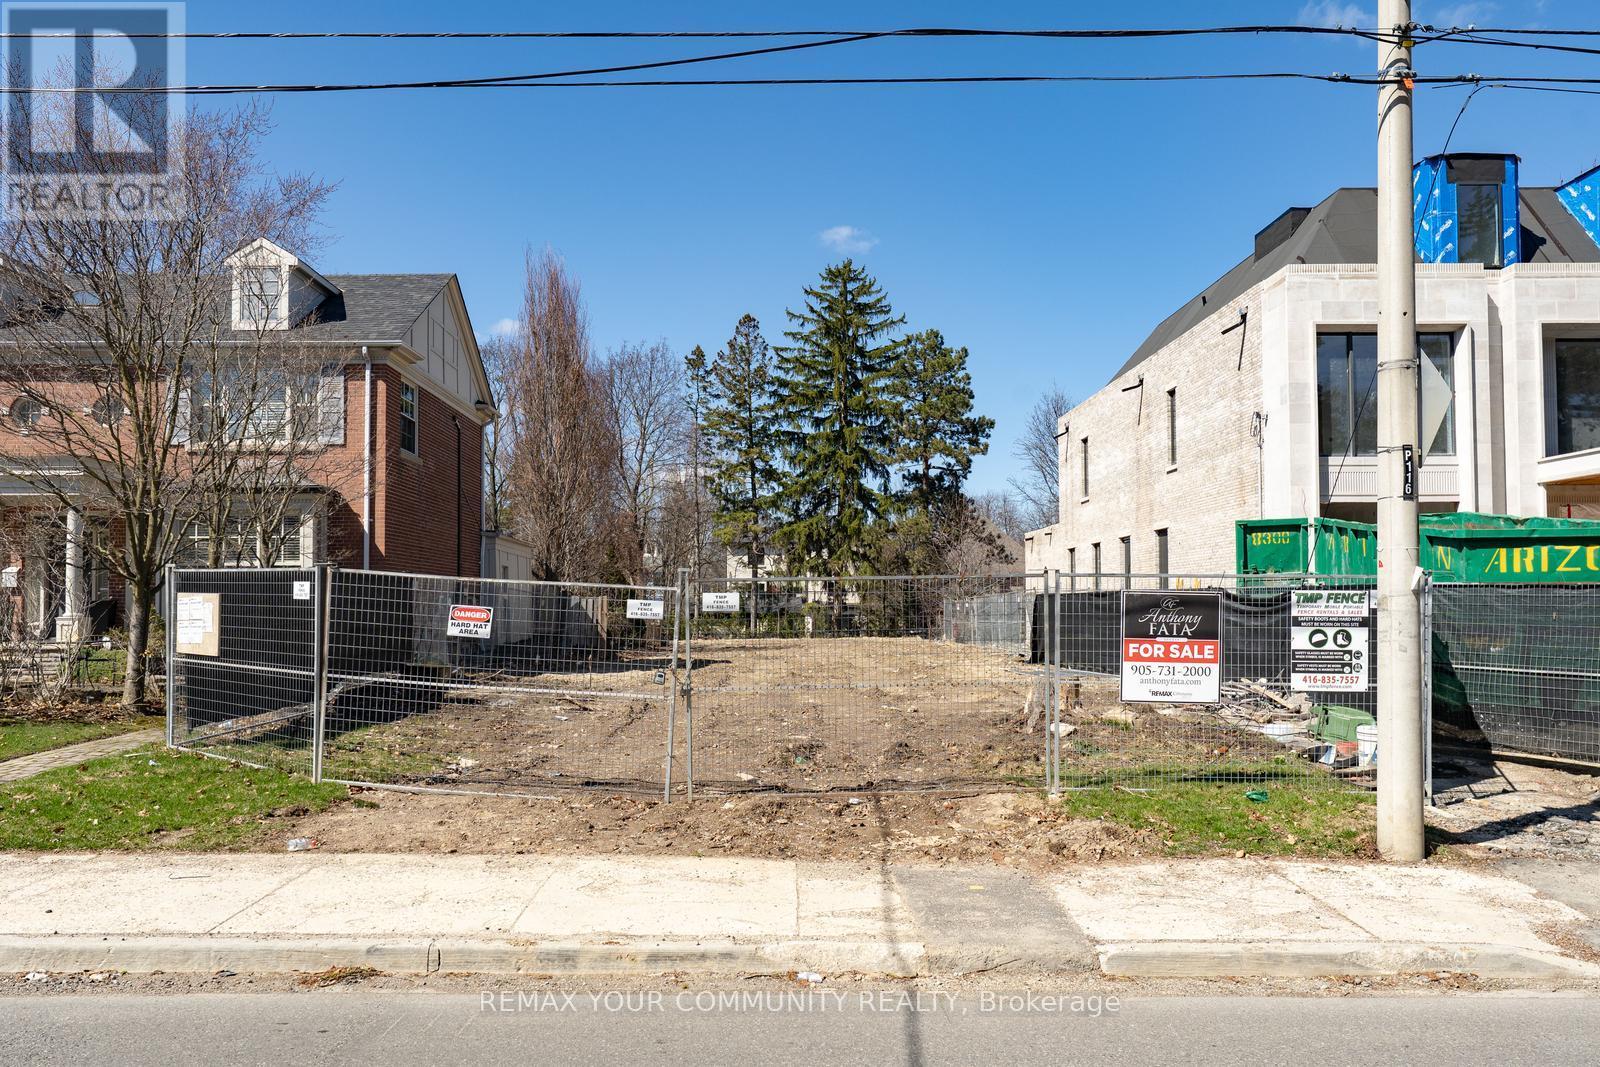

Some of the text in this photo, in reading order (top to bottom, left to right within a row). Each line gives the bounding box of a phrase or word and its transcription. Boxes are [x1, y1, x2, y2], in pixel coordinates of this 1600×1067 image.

[1295, 592, 1366, 604] TMP FENCE
[454, 610, 487, 618] DANGER
[1138, 607, 1203, 631] Anthony
[1149, 622, 1192, 636] FATA
[1129, 644, 1214, 658] FOR SALE
[1131, 665, 1212, 676] 905-731-2000
[1139, 677, 1202, 686] anthonyfata.com
[1302, 676, 1360, 684] 416-835-7557
